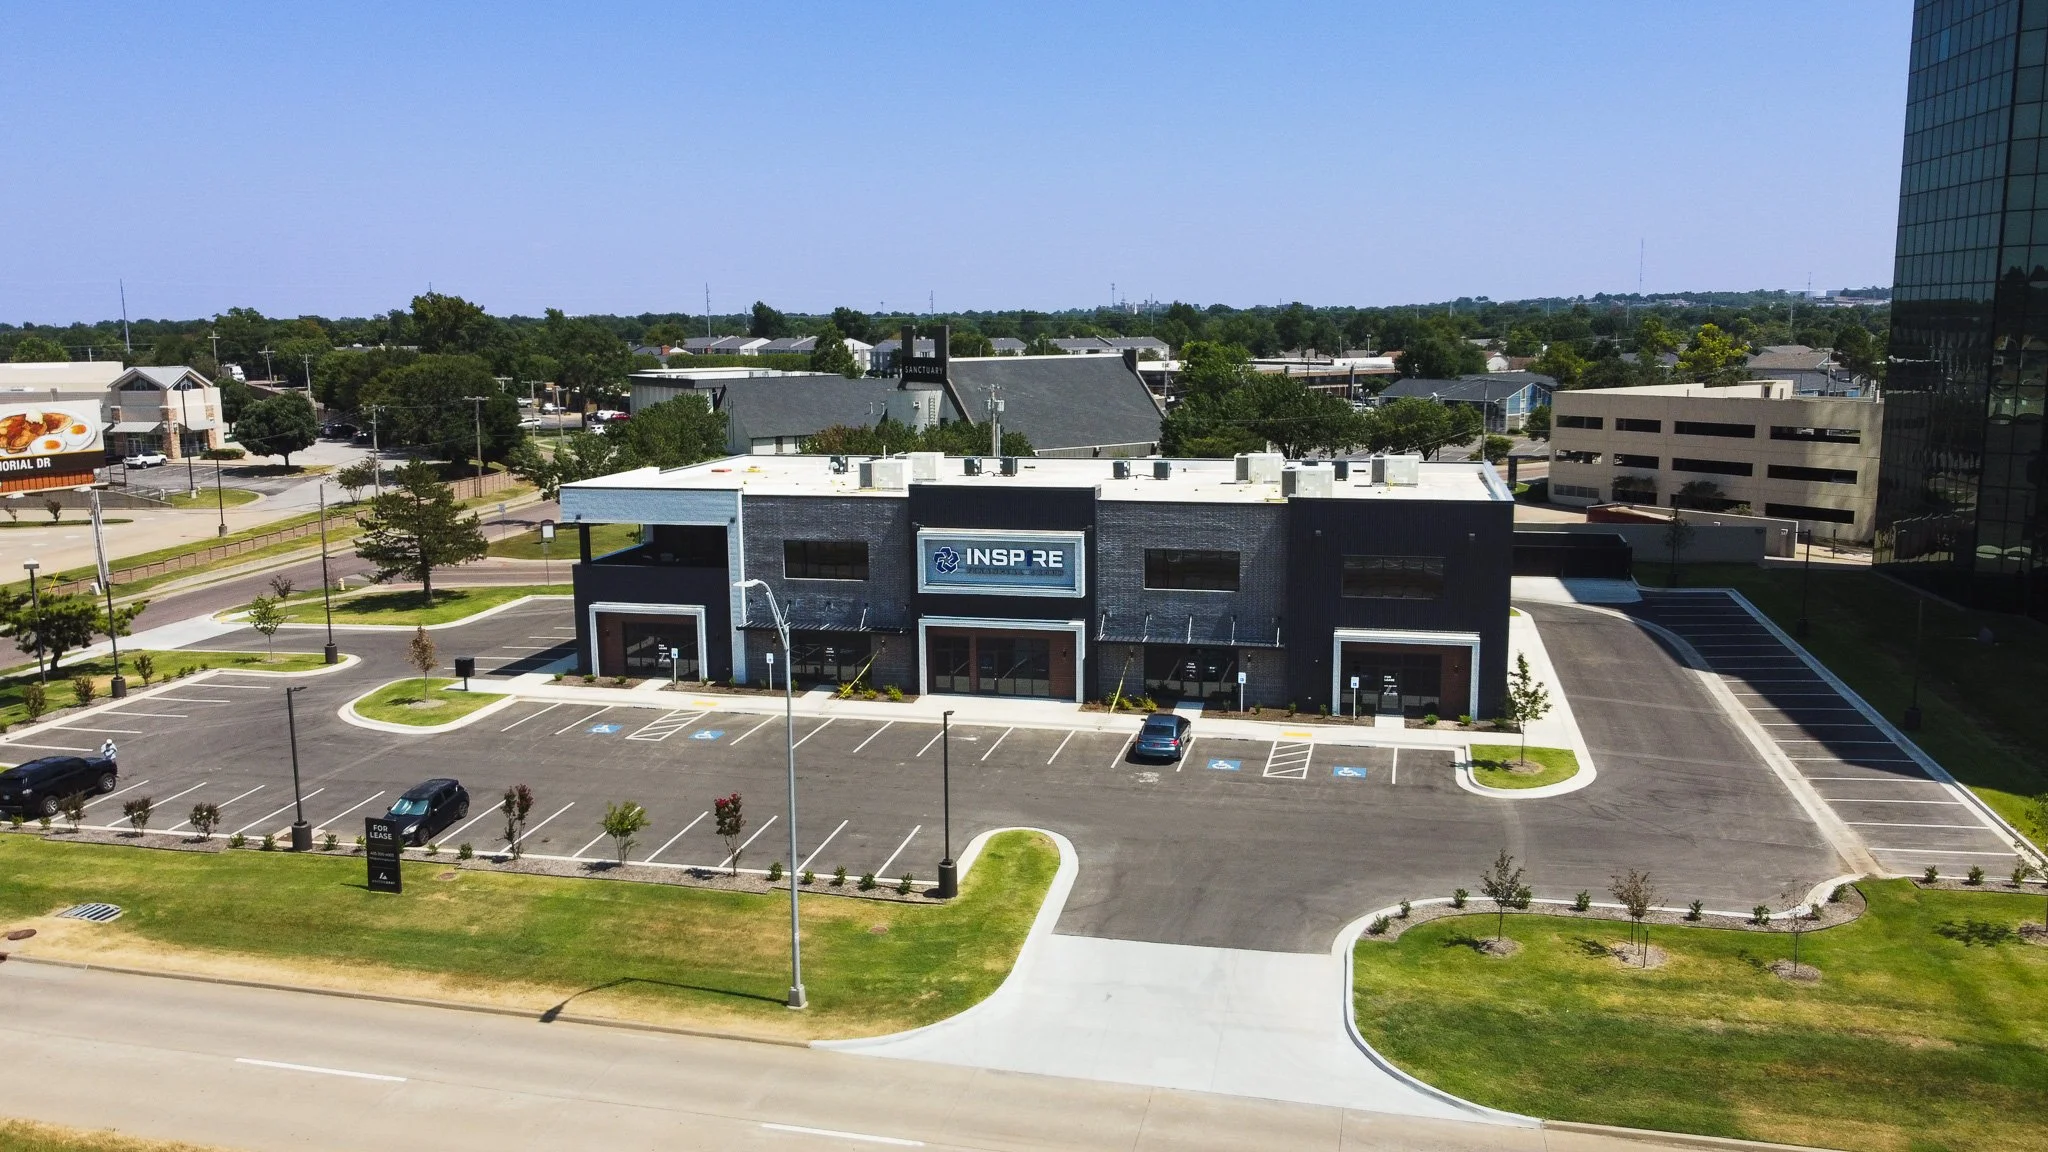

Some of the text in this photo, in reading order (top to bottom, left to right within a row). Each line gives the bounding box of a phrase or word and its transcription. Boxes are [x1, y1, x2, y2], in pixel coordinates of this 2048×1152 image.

[904, 365, 943, 375] SANCTUARY
[0, 457, 51, 472] ORIAL DR
[966, 548, 1063, 568] INSPIRE
[373, 824, 388, 832] FOR
[370, 831, 393, 840] LEASE
